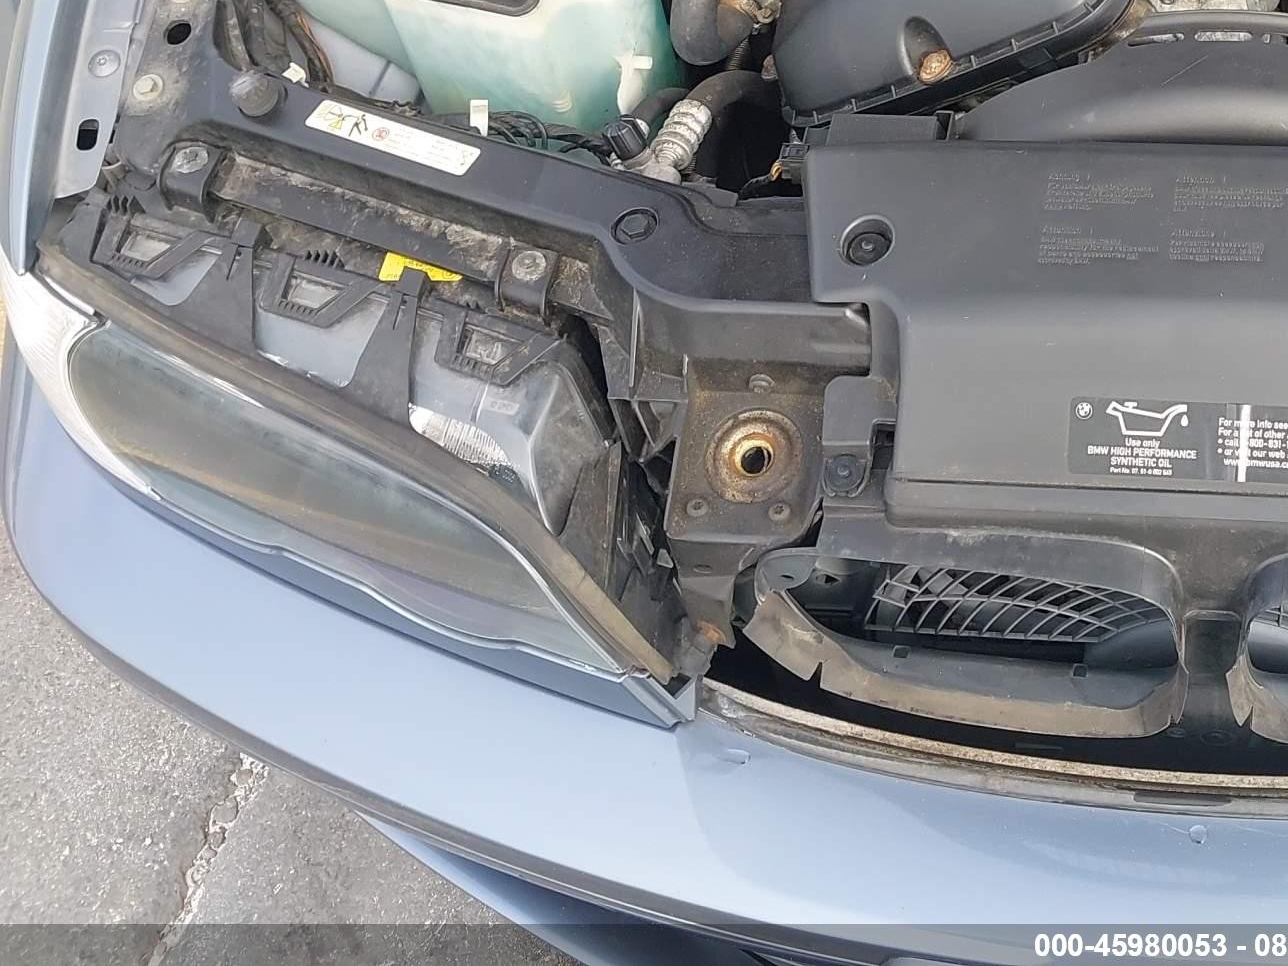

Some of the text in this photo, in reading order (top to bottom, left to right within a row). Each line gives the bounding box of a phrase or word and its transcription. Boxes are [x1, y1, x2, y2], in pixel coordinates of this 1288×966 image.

[1218, 417, 1233, 427] For
[1257, 419, 1273, 429] info
[1274, 421, 1288, 430] see
[1218, 426, 1232, 436] For
[1254, 429, 1263, 438] of
[1264, 429, 1286, 439] other
[1125, 437, 1161, 450] Use only
[1087, 445, 1198, 460] BMW HIGH PERFORMANCE
[1252, 450, 1267, 458] our
[1268, 449, 1286, 459] web
[1110, 456, 1173, 468] SYNTHETIC OIL
